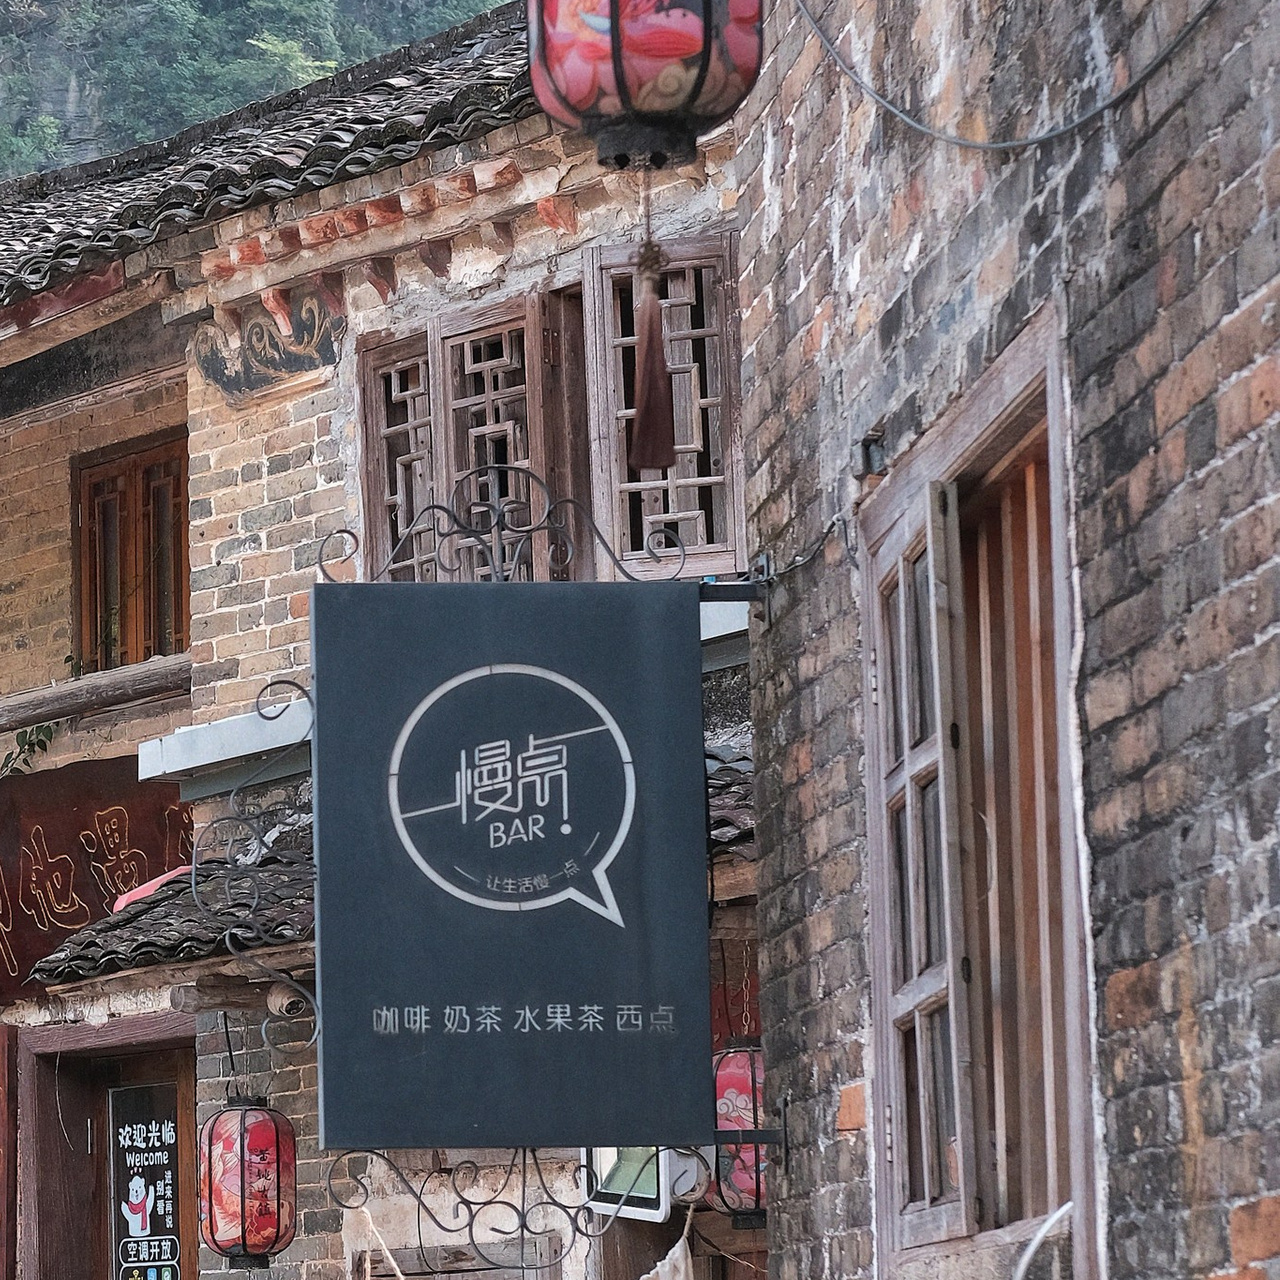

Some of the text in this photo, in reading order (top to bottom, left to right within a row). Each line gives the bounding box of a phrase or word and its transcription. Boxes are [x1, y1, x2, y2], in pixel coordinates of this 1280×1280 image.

[489, 814, 546, 850] BAR
[486, 859, 581, 894] 让生活慢一点
[372, 1004, 677, 1035] 咖啡 奶茶 水果茶 西点
[119, 1120, 176, 1149] 欢迎光临
[125, 1150, 169, 1168] Welcome
[127, 1240, 172, 1262] 空调开放
